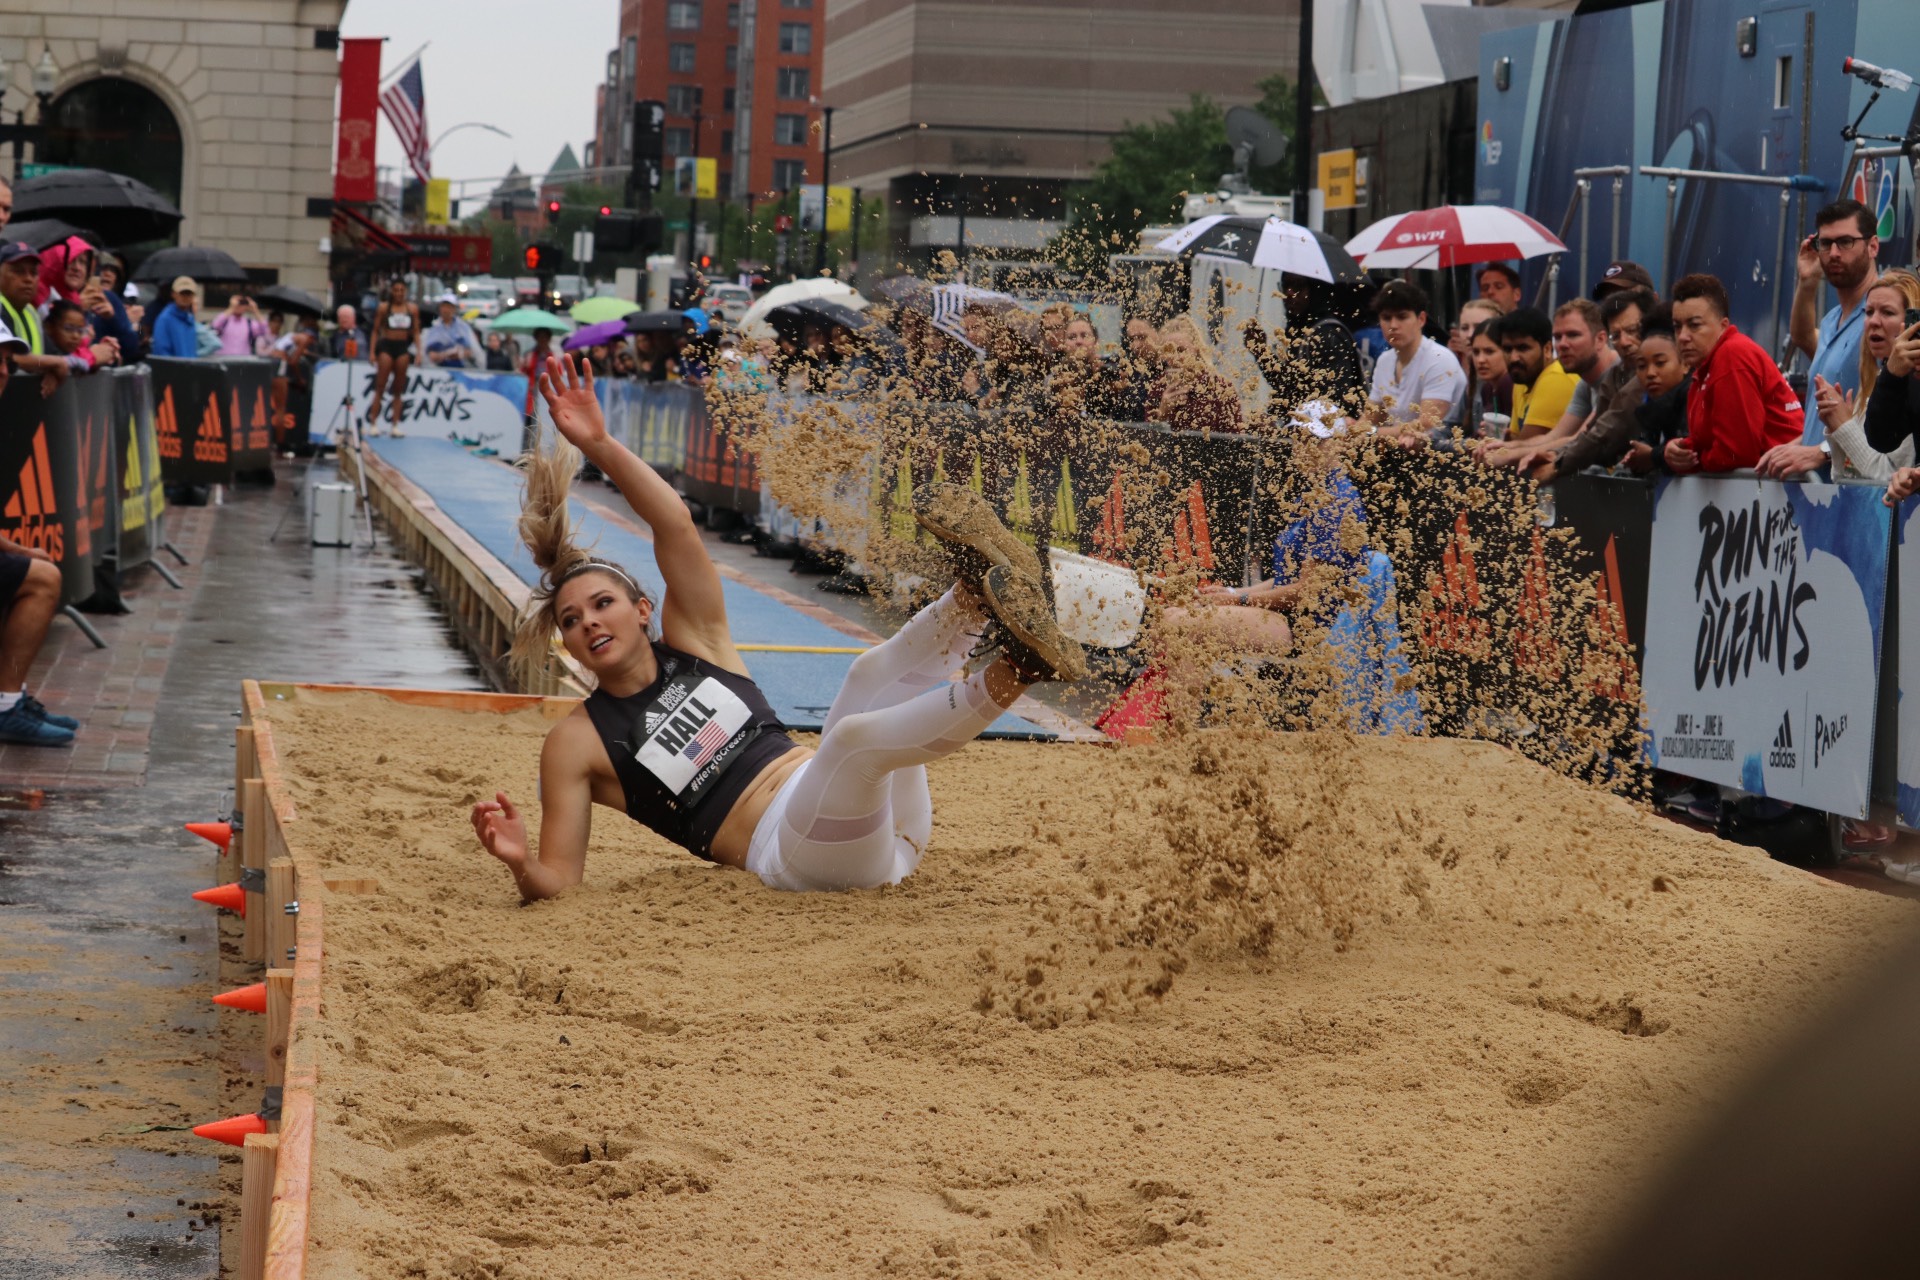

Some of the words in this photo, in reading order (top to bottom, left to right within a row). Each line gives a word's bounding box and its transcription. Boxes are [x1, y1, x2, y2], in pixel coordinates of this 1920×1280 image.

[1414, 230, 1446, 242] WPI
[1771, 501, 1798, 539] FOR
[1695, 499, 1772, 608] RUN
[1774, 536, 1797, 575] THE
[1695, 560, 1817, 691] OCEANS
[657, 683, 678, 704] BOOST
[662, 683, 686, 708] BOSTON
[667, 691, 688, 712] GAMES
[646, 712, 668, 735] adidas
[653, 696, 718, 757] HALL
[1675, 714, 1688, 735] JUNE
[1703, 715, 1717, 736] JUNE
[690, 730, 746, 792] #HereToCreate
[1769, 747, 1796, 768] adidas
